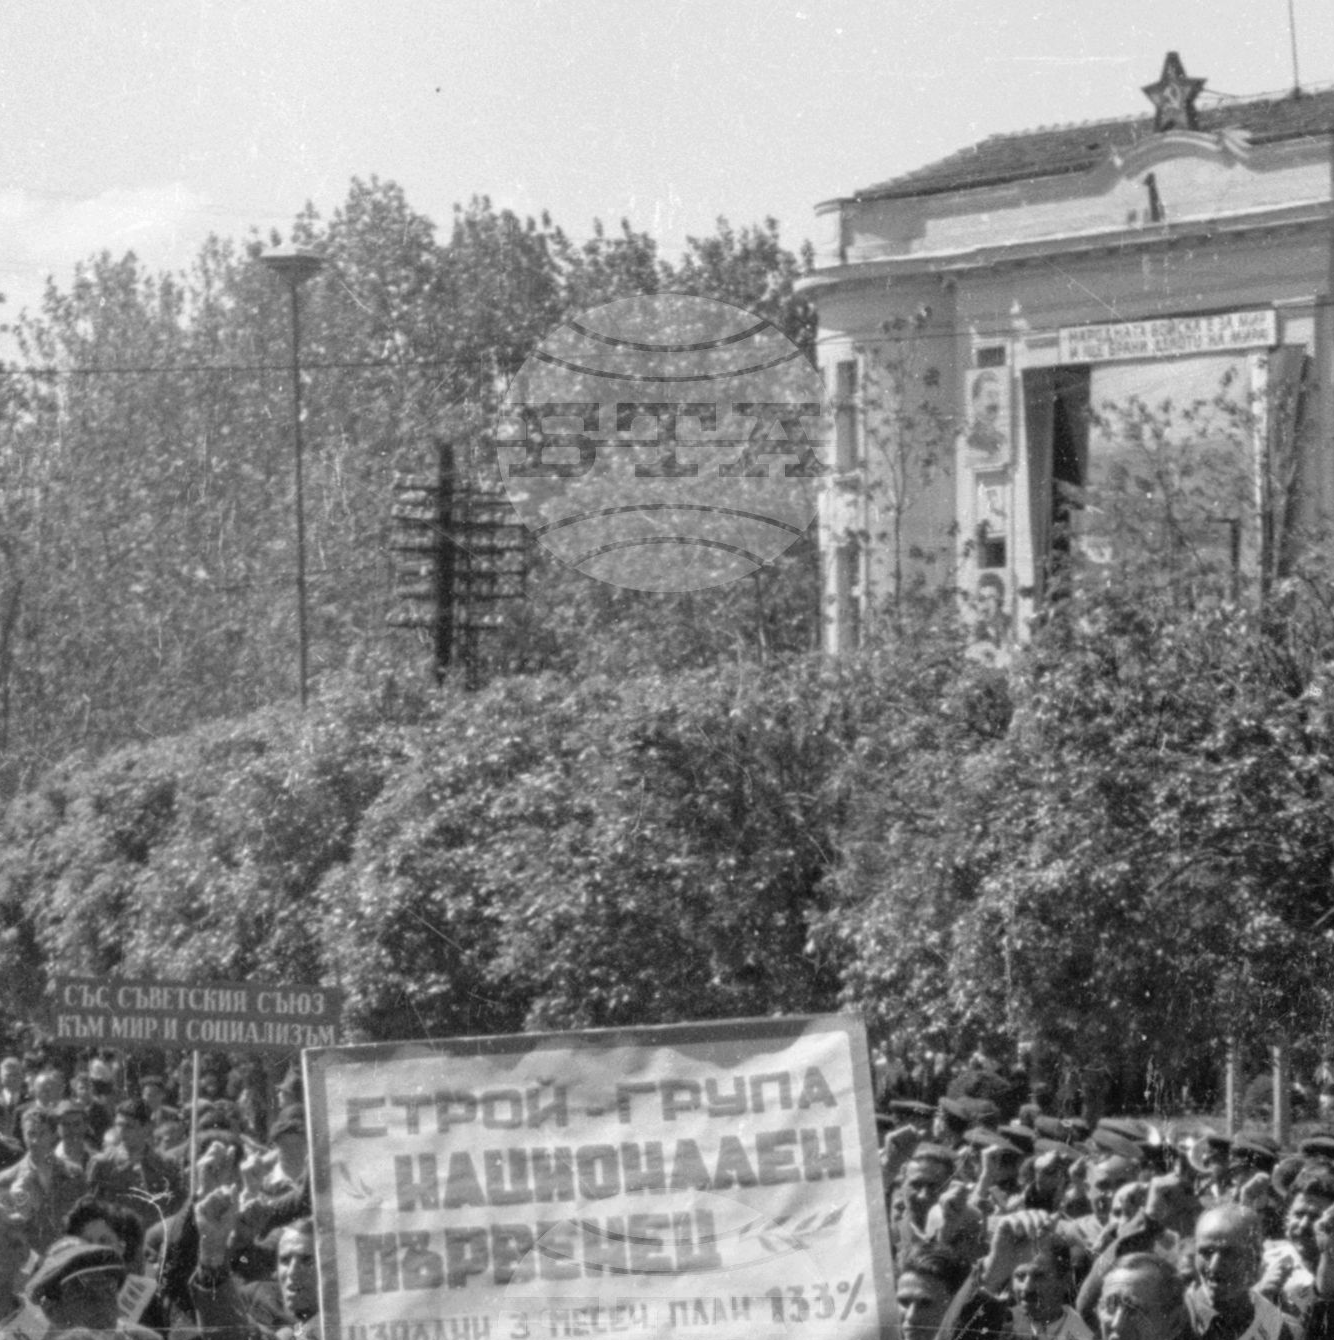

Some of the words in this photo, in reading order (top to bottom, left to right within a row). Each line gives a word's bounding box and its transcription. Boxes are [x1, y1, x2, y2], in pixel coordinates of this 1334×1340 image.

[64, 984, 110, 1008] СЪС
[117, 985, 248, 1013] СЪВЕТСКИЯ
[256, 991, 326, 1016] СЪЮЗ
[56, 1014, 104, 1039] КЪМ
[111, 1016, 158, 1039] МИР
[164, 1018, 178, 1042] И
[185, 1018, 336, 1047] СОЦИАЛИЗЪМ
[393, 1125, 846, 1213] НАЦИОНАЛЕН
[355, 1209, 722, 1296] ПЪРВЕНЕЦ
[669, 1294, 751, 1328] ПЛАН
[766, 1273, 865, 1324] 133%
